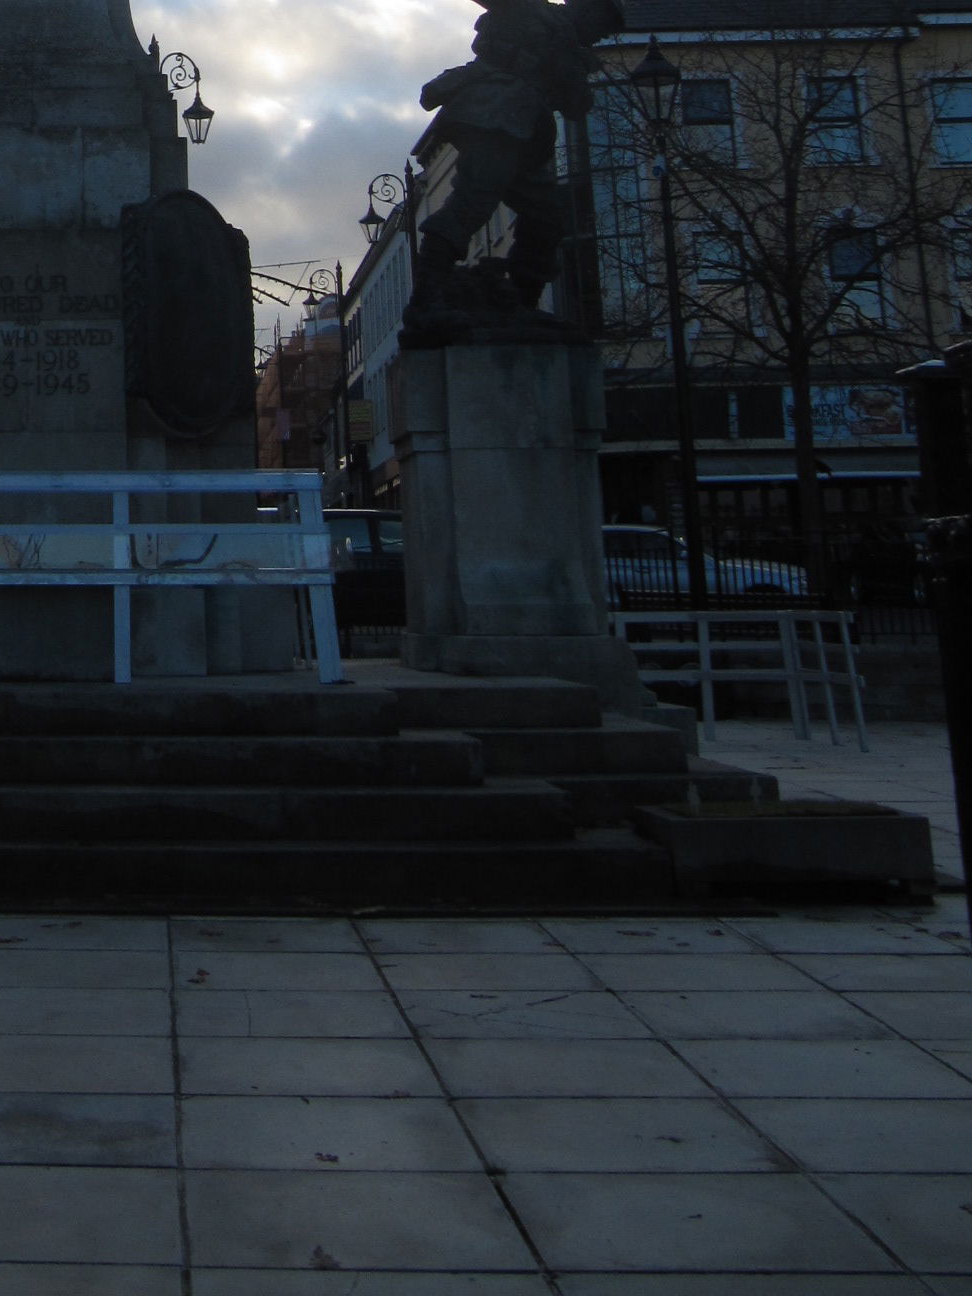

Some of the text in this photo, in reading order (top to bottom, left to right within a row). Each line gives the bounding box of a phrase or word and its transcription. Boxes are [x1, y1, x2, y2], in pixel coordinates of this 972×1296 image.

[24, 274, 68, 292] OUR
[59, 294, 119, 313] DEAD
[0, 329, 38, 347] WHO
[45, 329, 113, 347] SERVED
